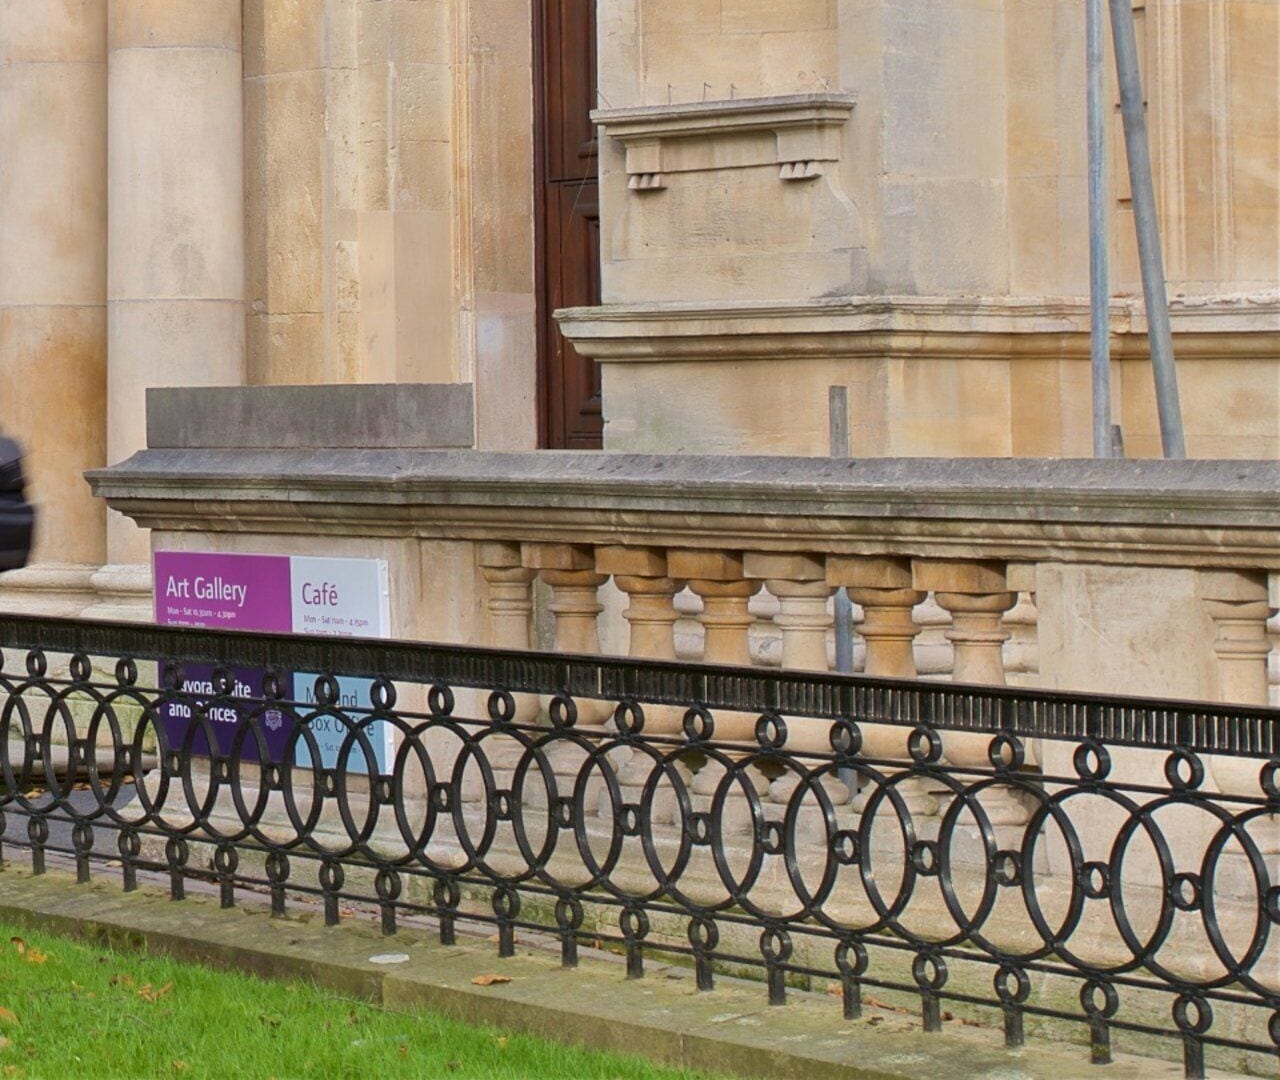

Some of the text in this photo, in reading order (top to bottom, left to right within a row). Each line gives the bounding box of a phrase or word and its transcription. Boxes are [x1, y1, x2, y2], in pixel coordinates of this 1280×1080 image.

[166, 575, 247, 608] Art Gallery
[302, 582, 338, 606] Café
